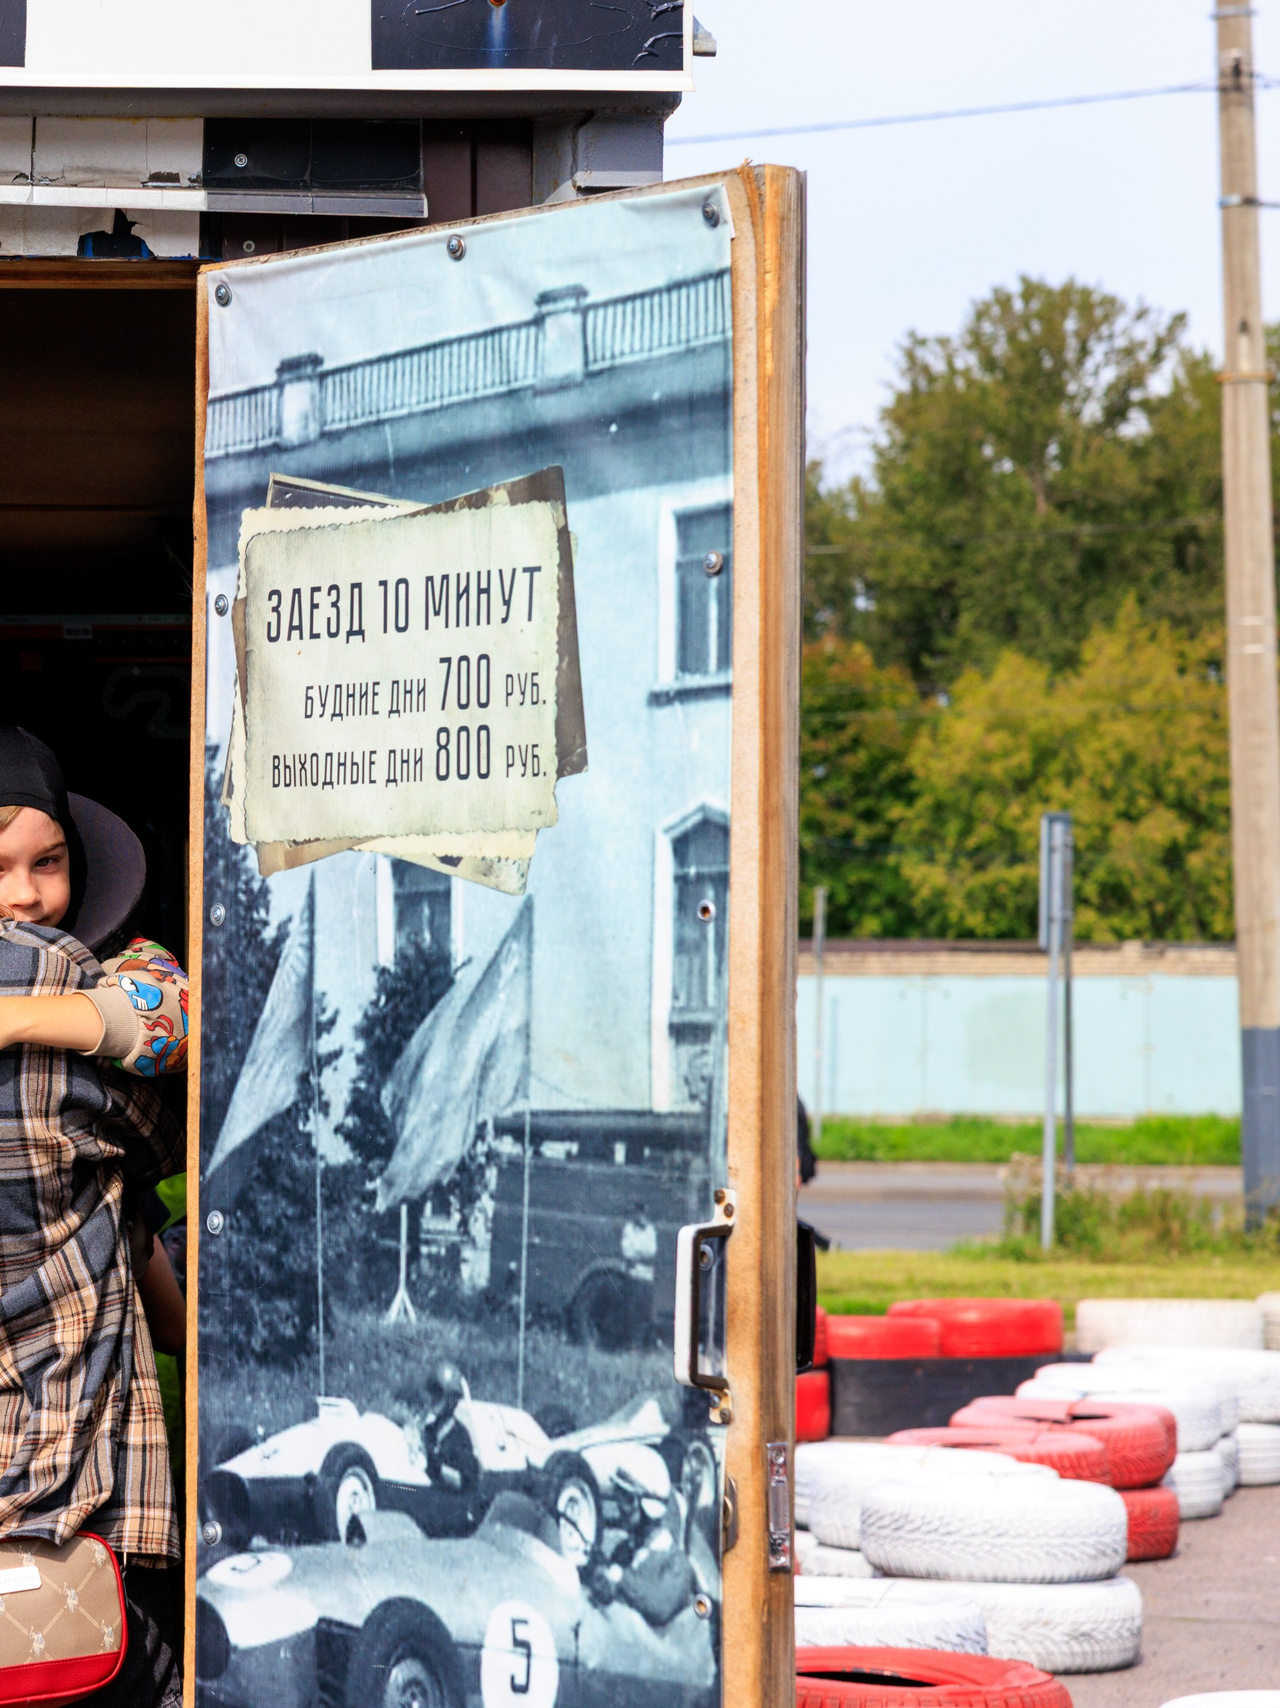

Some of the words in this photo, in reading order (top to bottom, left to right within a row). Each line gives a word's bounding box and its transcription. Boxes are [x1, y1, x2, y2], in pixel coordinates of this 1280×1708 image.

[266, 582, 365, 645] ЗАЕЗД
[378, 577, 410, 634] 10
[424, 566, 542, 631] МИНУТ
[304, 681, 381, 721] БУДНИЕ
[388, 678, 427, 718] ДНИ
[439, 653, 491, 711] 700
[505, 672, 547, 708] РУБ.
[271, 750, 377, 790] ВЫХОДНЫЕ
[385, 748, 424, 788] ДНИ
[435, 724, 491, 782] 800
[505, 744, 547, 779] РУБ.
[510, 1618, 532, 1695] 5
